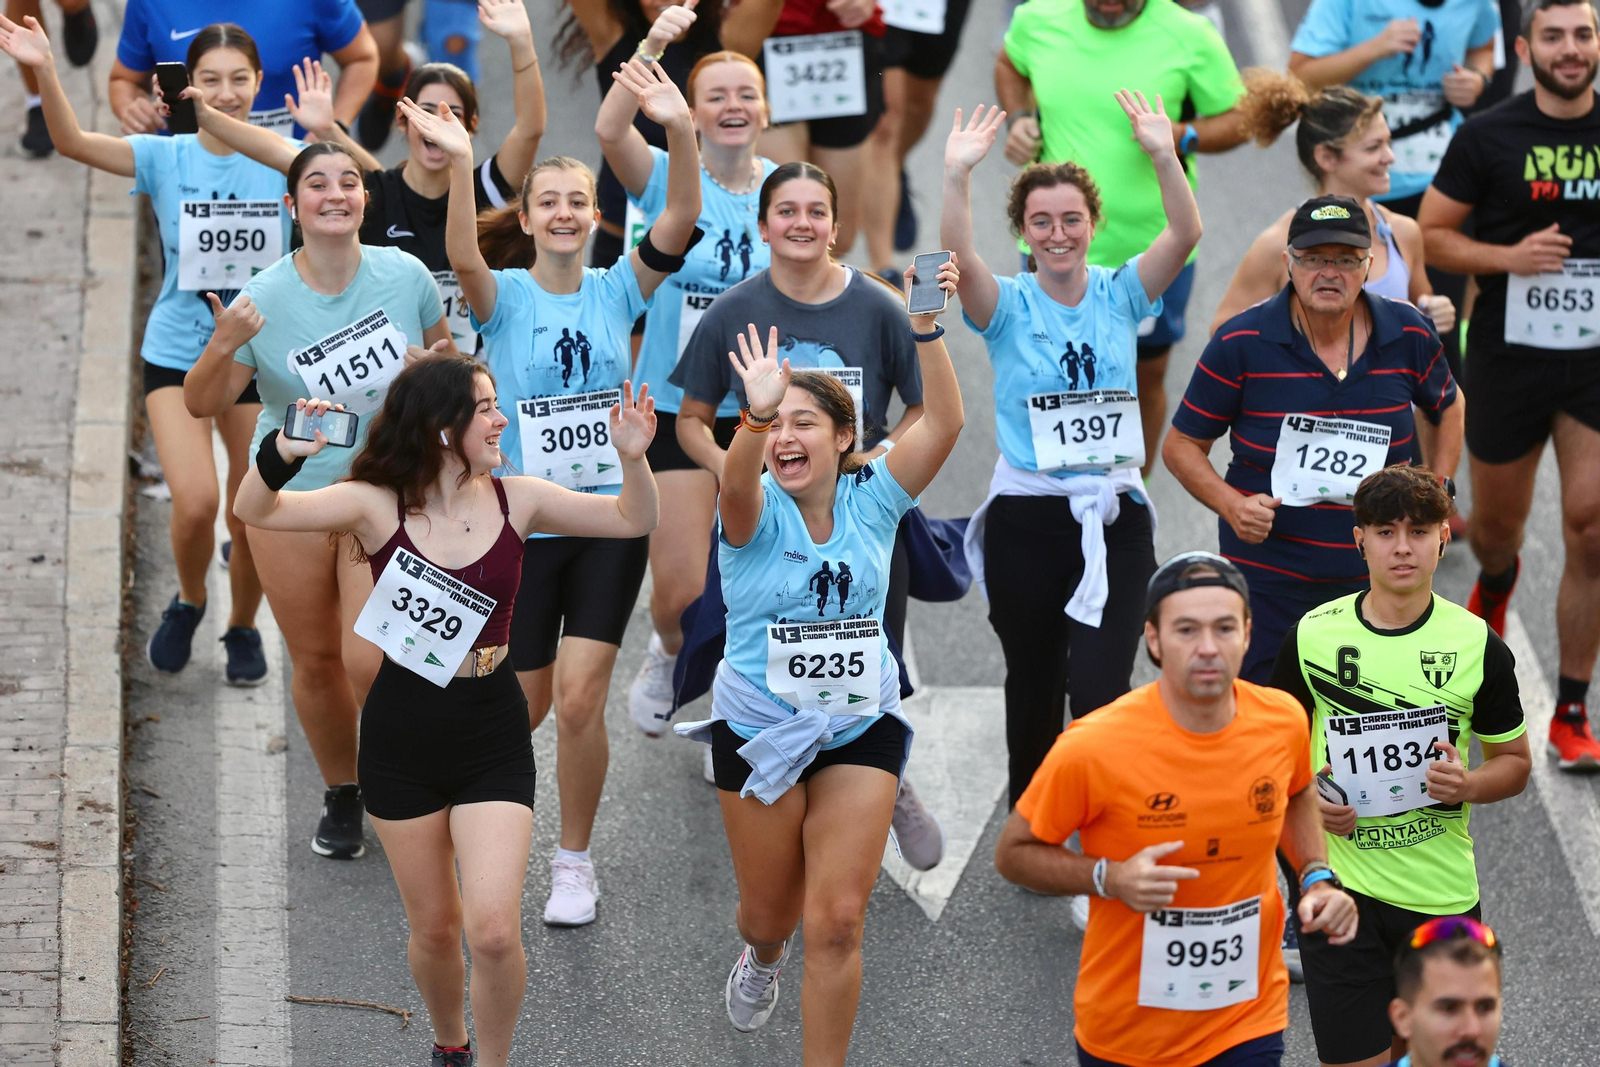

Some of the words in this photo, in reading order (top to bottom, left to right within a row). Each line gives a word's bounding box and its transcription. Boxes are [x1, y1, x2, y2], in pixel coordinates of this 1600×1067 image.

[785, 58, 847, 87] 3422
[1530, 181, 1559, 200] TO
[1564, 180, 1600, 200] LIV
[185, 203, 210, 218] 43
[199, 229, 265, 252] 9950
[686, 295, 714, 310] 43
[1526, 286, 1594, 312] 6653
[296, 344, 326, 366] 43
[320, 327, 354, 348] CARRERA
[354, 309, 385, 330] URBANA
[319, 337, 400, 395] 11511
[521, 400, 550, 418] 43
[551, 396, 587, 407] CARRERA
[589, 391, 619, 401] URBANA
[1031, 394, 1061, 411] 43
[541, 421, 609, 453] 3098
[1053, 413, 1122, 445] 1397
[1287, 416, 1316, 433] 43
[1317, 420, 1354, 431] CARRERA
[1356, 424, 1390, 437] URBANA
[1296, 443, 1367, 478] 1282
[396, 550, 426, 580] 43
[425, 567, 463, 592] CARRERA
[462, 586, 495, 609] URBANA
[422, 574, 446, 592] CIUDAD
[392, 587, 462, 641] 3329
[771, 626, 802, 644] 43
[801, 623, 841, 632] CARRERA
[843, 620, 878, 630] URBANA
[788, 651, 864, 678] 6235
[1336, 645, 1361, 689] 6
[1329, 717, 1362, 736] 43
[1362, 713, 1405, 724] CARRERA
[1407, 706, 1446, 719] URBANA
[1362, 722, 1390, 731] CIUDAD
[1343, 736, 1443, 774] 11834
[1137, 813, 1187, 822] HYUNDAI
[1358, 827, 1444, 848] WWW.FONTACO.COM
[1151, 910, 1182, 927] 43
[1167, 934, 1242, 967] 9953
